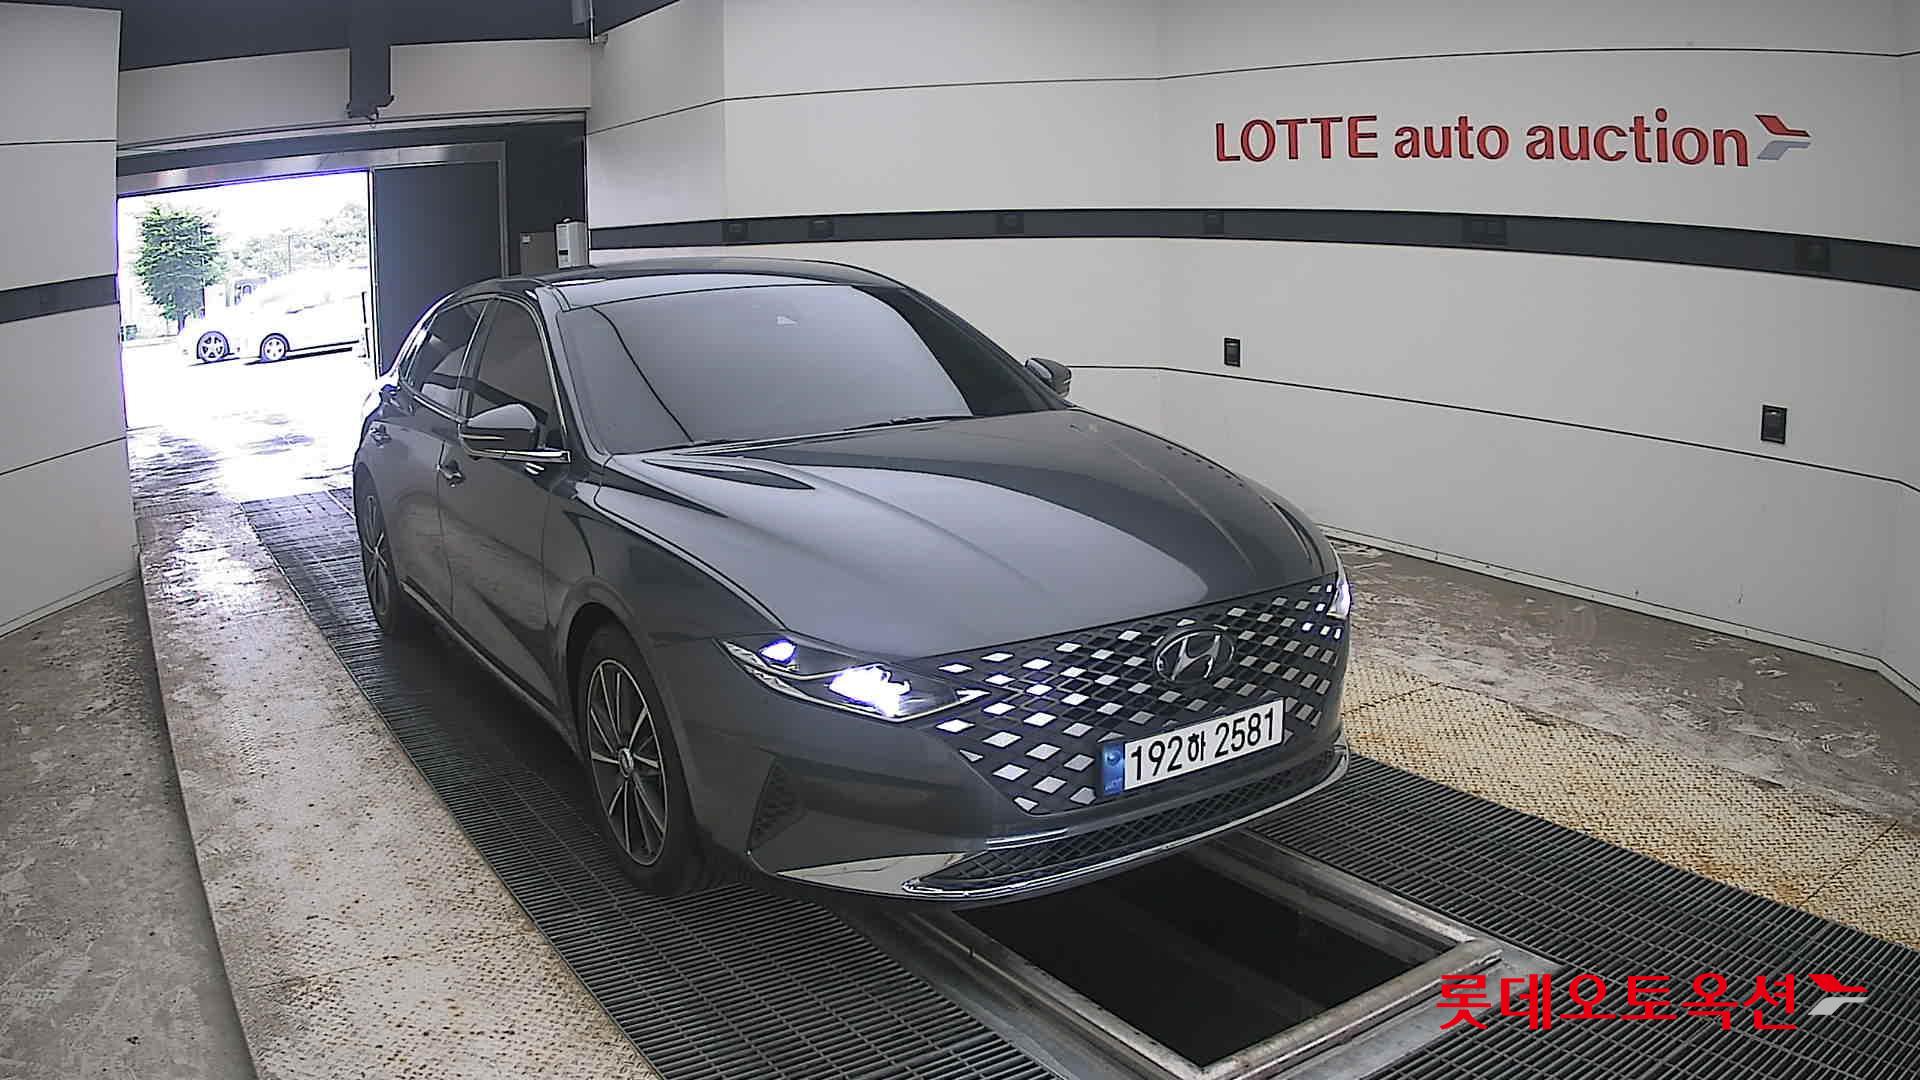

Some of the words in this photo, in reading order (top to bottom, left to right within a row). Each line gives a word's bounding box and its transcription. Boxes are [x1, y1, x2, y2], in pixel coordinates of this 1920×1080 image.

[1215, 115, 1378, 162] LOTTE
[1393, 115, 1510, 160] auto
[1526, 108, 1750, 167] auction
[1131, 731, 1206, 780] 192하
[1214, 708, 1274, 758] 2581
